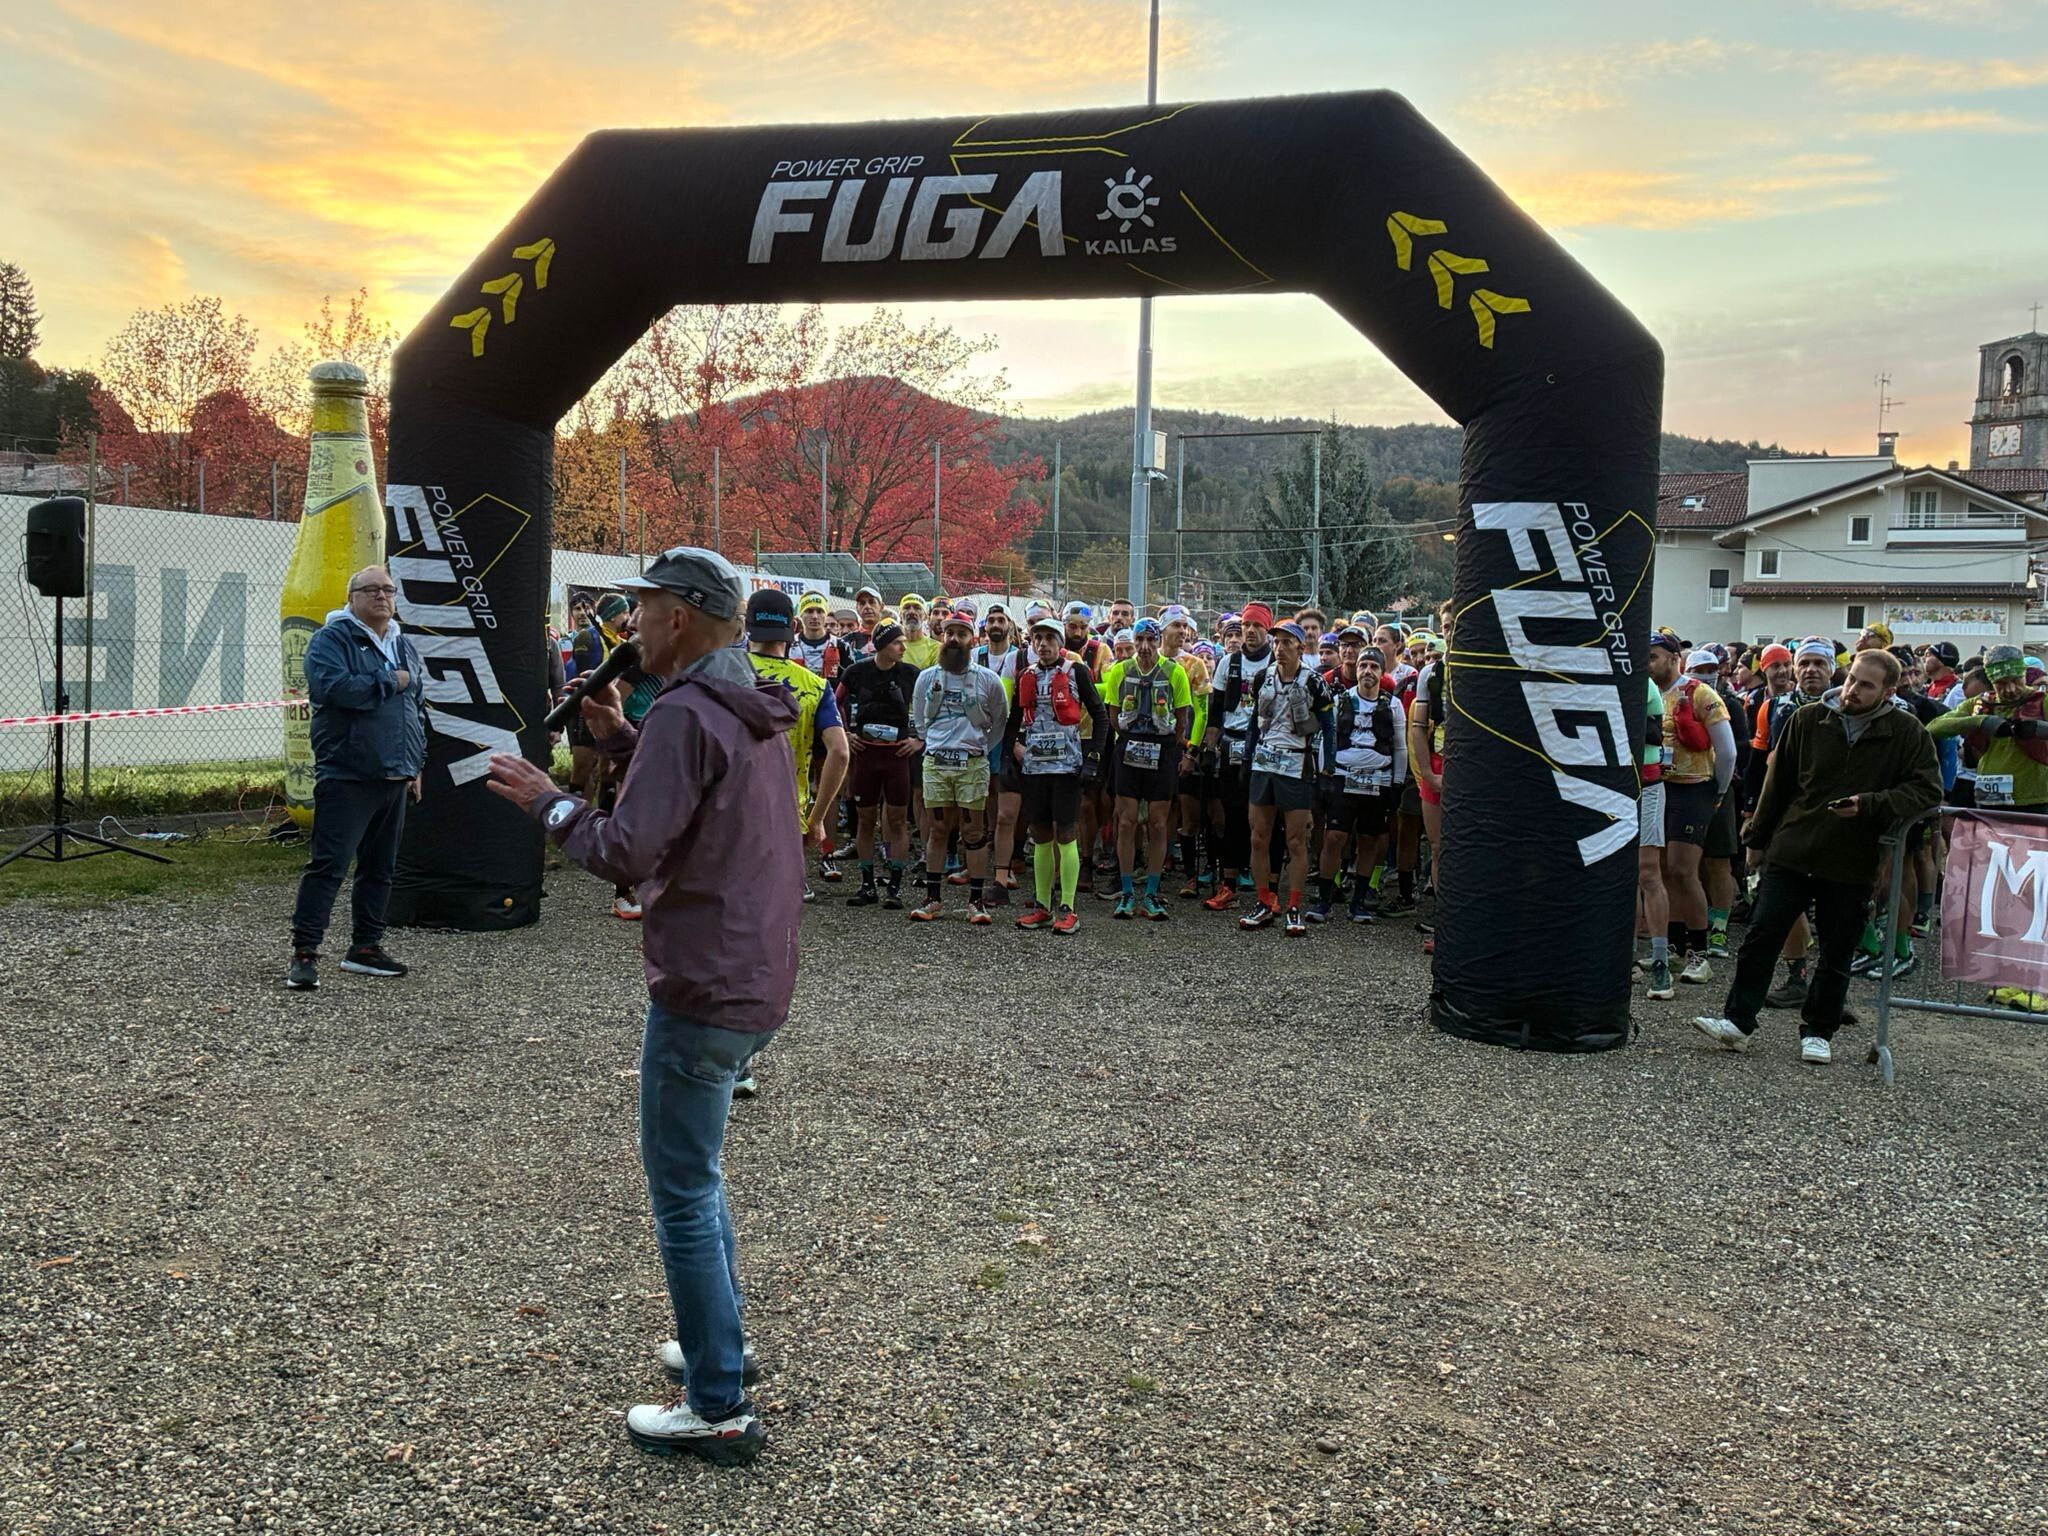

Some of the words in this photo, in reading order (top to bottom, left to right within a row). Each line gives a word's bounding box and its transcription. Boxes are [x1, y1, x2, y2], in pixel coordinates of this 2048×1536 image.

[771, 159, 861, 178] POWER
[864, 155, 924, 176] GRIP
[748, 170, 1066, 264] FUGA
[1085, 236, 1177, 256] KAILAS
[425, 485, 474, 569] POWER
[462, 575, 498, 630] GRIP
[1563, 502, 1615, 603] POWER
[1603, 611, 1633, 676] GRIP
[386, 484, 522, 786] FUGA
[1472, 502, 1639, 867] FUGA
[1038, 739, 1057, 750] 322
[1984, 782, 1999, 793] 90
